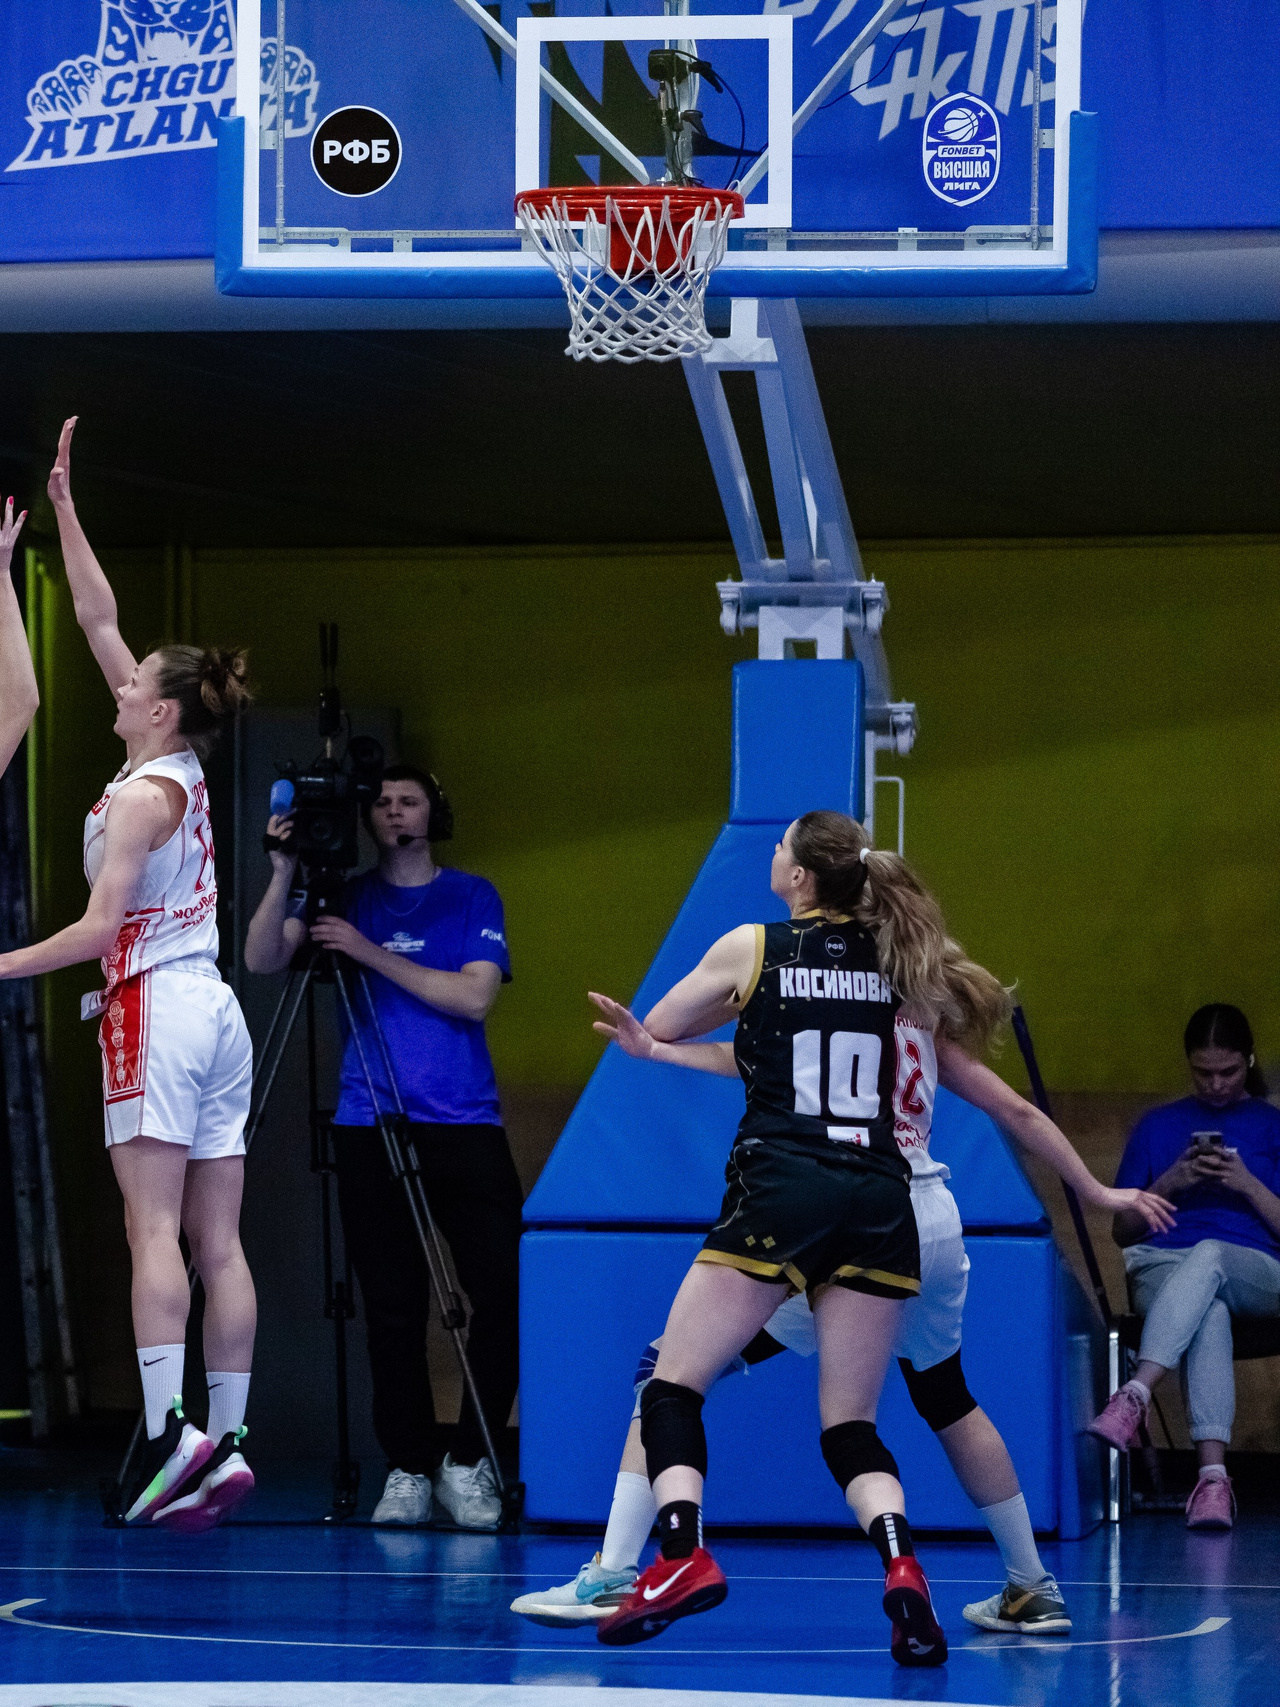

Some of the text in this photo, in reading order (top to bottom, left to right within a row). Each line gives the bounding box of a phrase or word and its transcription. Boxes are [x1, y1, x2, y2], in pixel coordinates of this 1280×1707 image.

[101, 57, 236, 109] CHGU
[322, 139, 391, 165] РФБ
[941, 146, 982, 156] FONBET
[933, 161, 990, 179] ВЫСШАЯ
[942, 181, 981, 191] ЛИГА
[779, 967, 892, 1003] КОСИНОВА
[792, 1029, 883, 1119] 10
